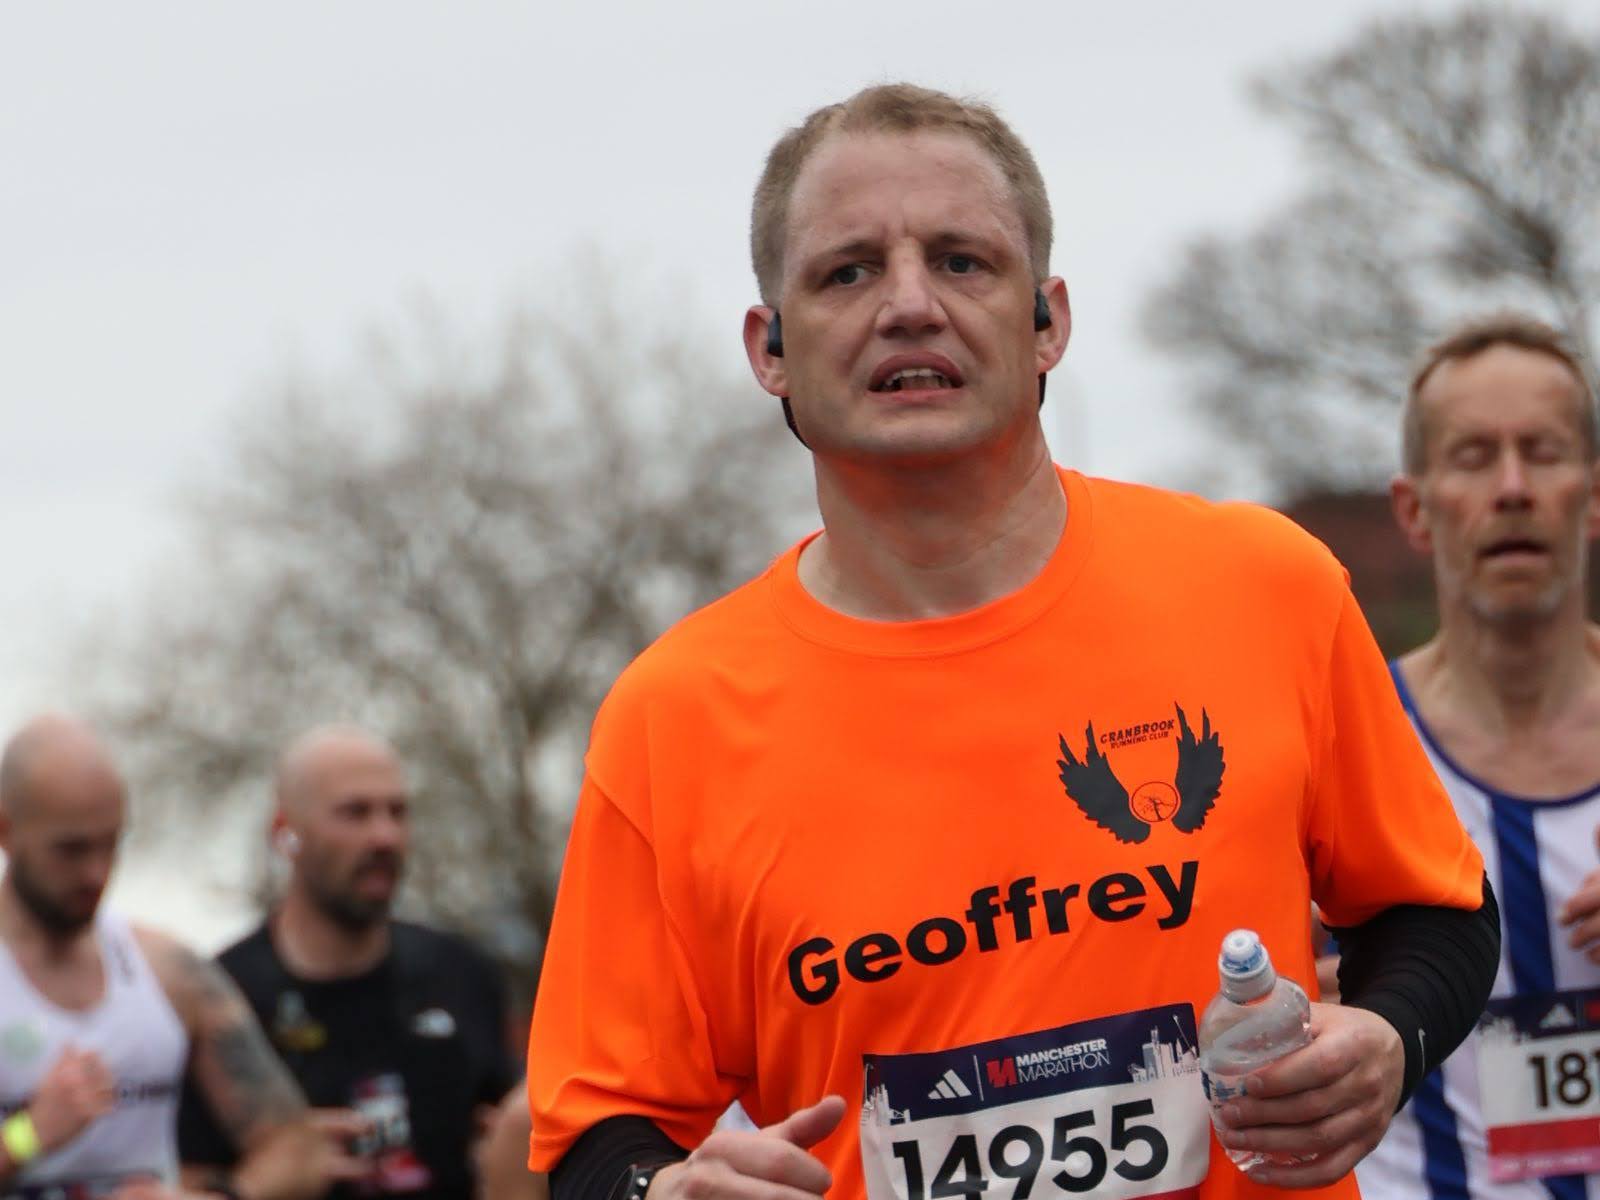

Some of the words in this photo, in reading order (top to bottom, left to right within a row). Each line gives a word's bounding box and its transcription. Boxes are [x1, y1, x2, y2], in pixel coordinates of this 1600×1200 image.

[1100, 719, 1175, 745] CRANBROOK
[1149, 731, 1169, 741] CLUB
[788, 861, 1199, 1006] Geoffrey
[1016, 1038, 1107, 1067] MANCHESTER
[1018, 1051, 1111, 1084] MARATHON
